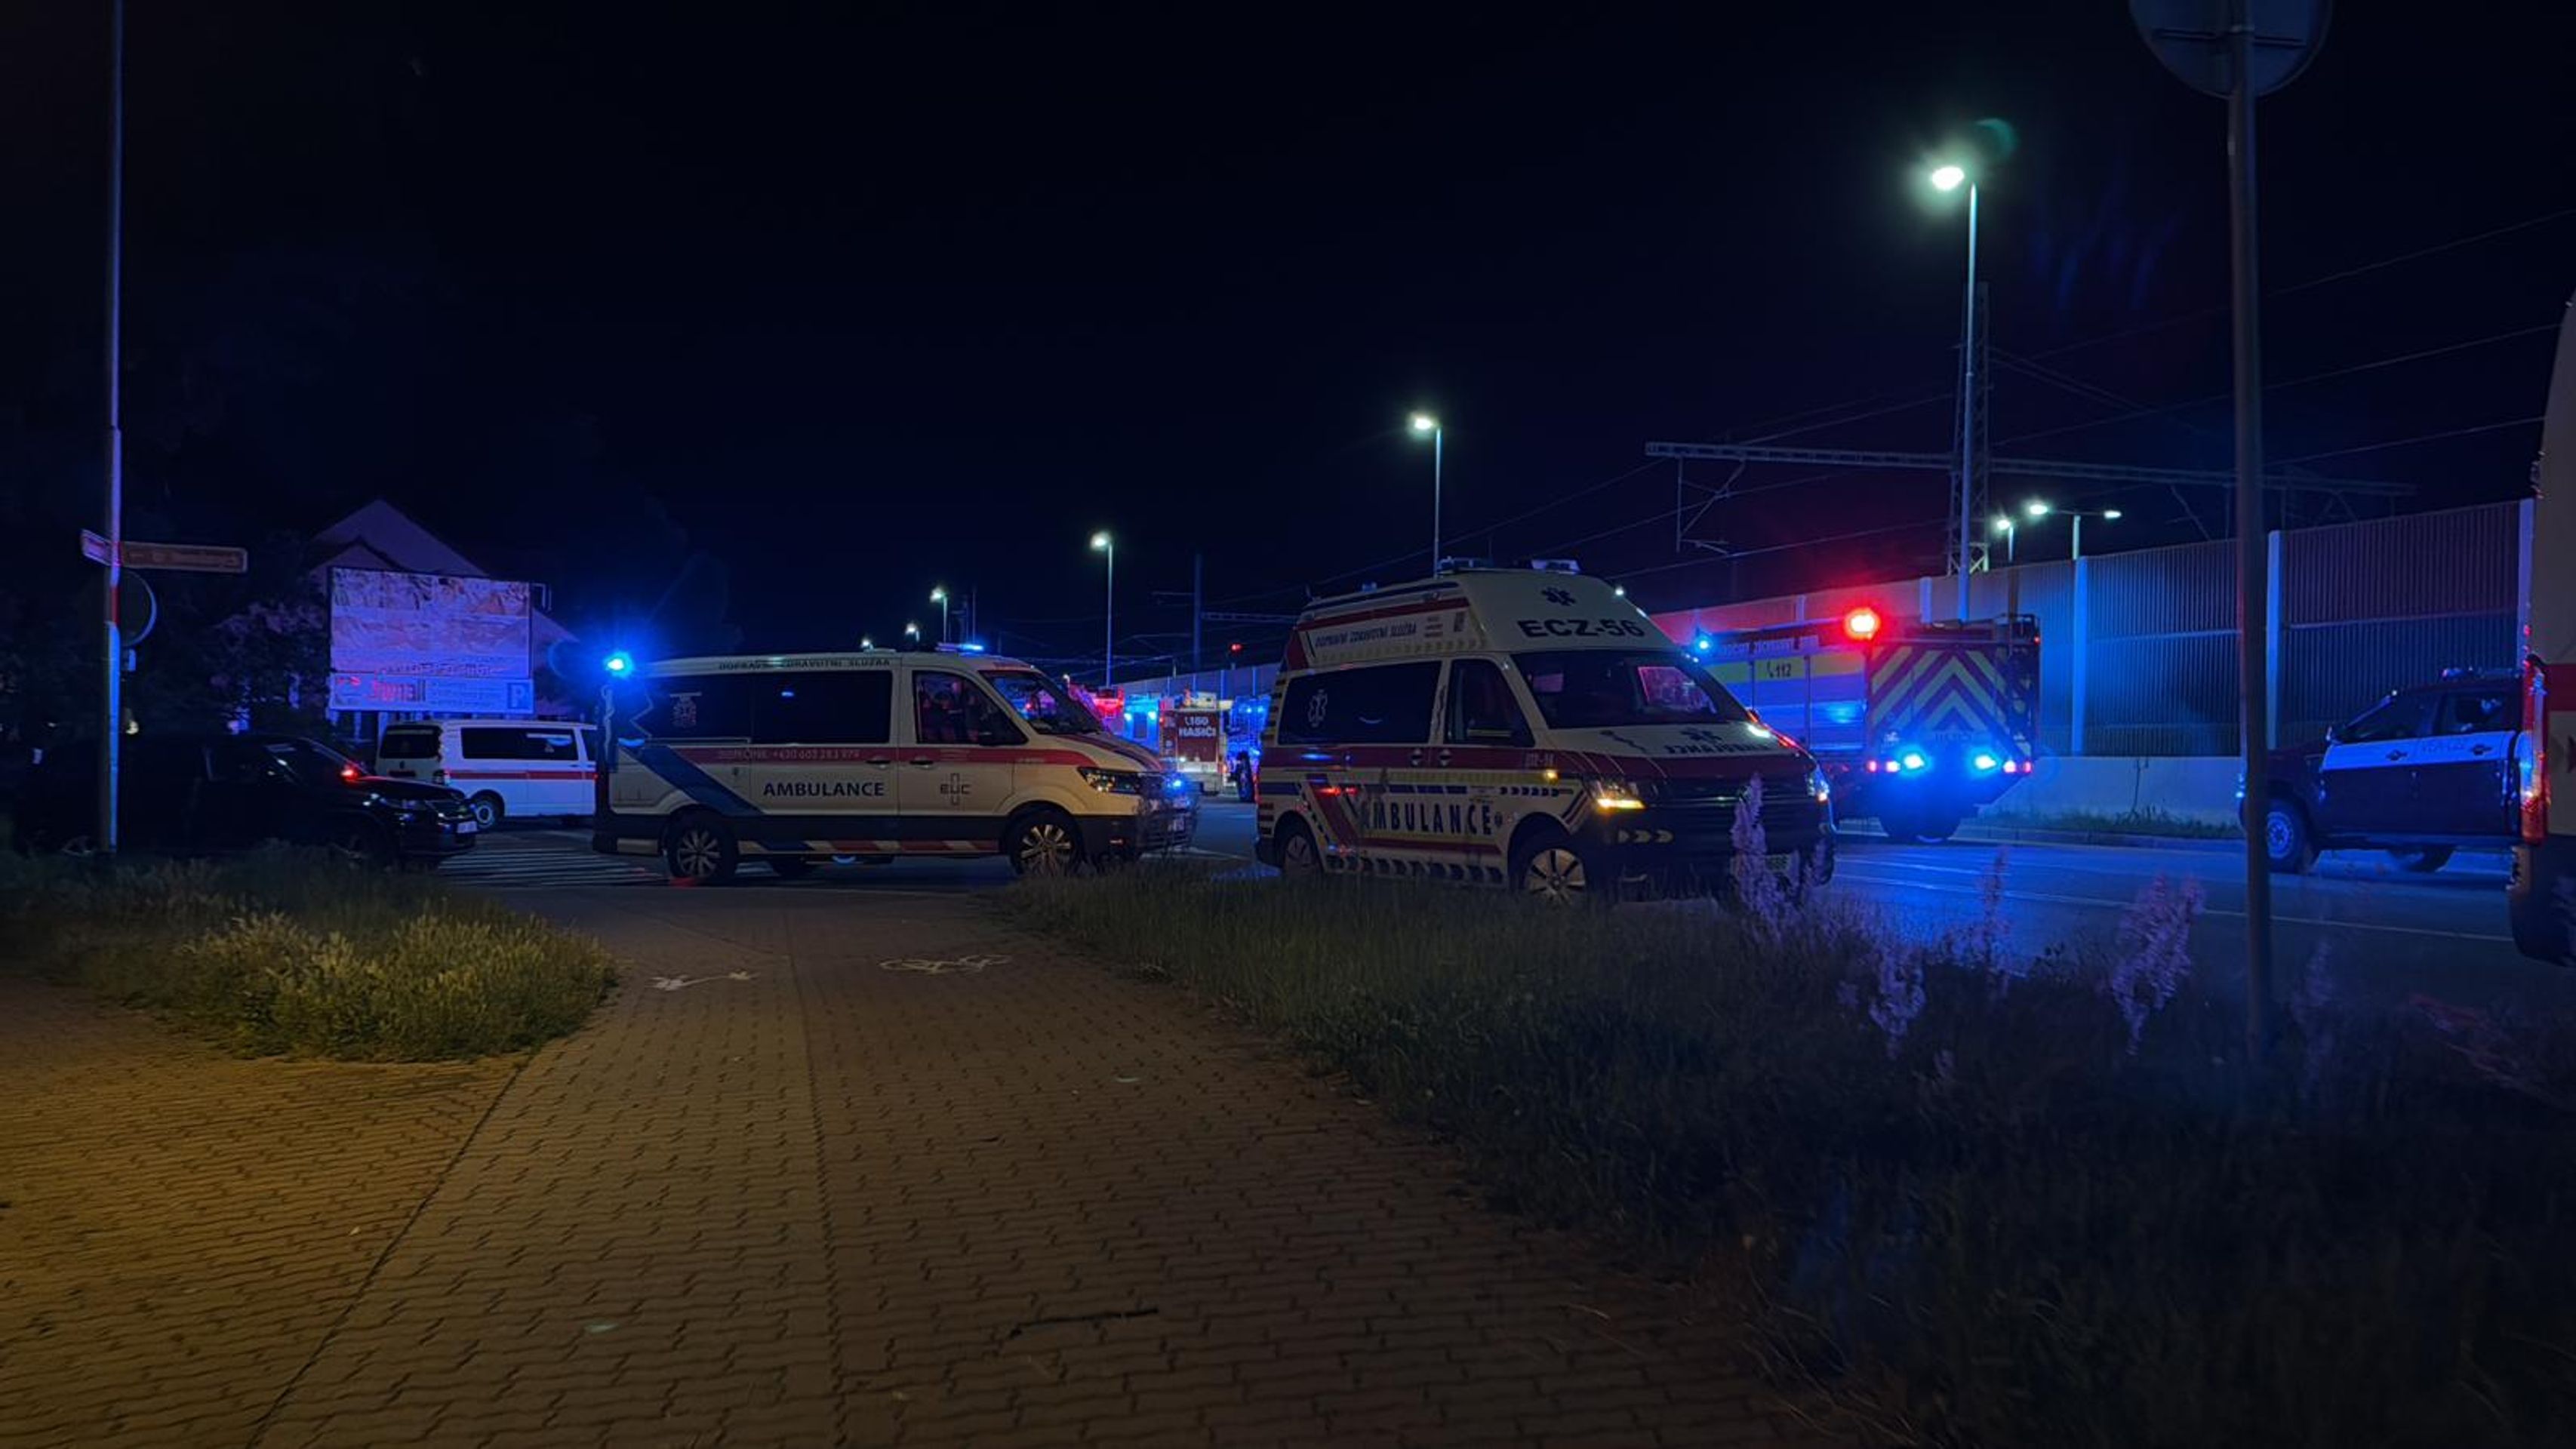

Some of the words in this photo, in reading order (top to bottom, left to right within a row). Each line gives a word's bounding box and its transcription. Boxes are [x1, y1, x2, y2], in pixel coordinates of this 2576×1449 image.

[1518, 620, 1645, 637] ECZ-56
[1776, 663, 1792, 677] 112
[763, 783, 884, 796] AMBULANCE
